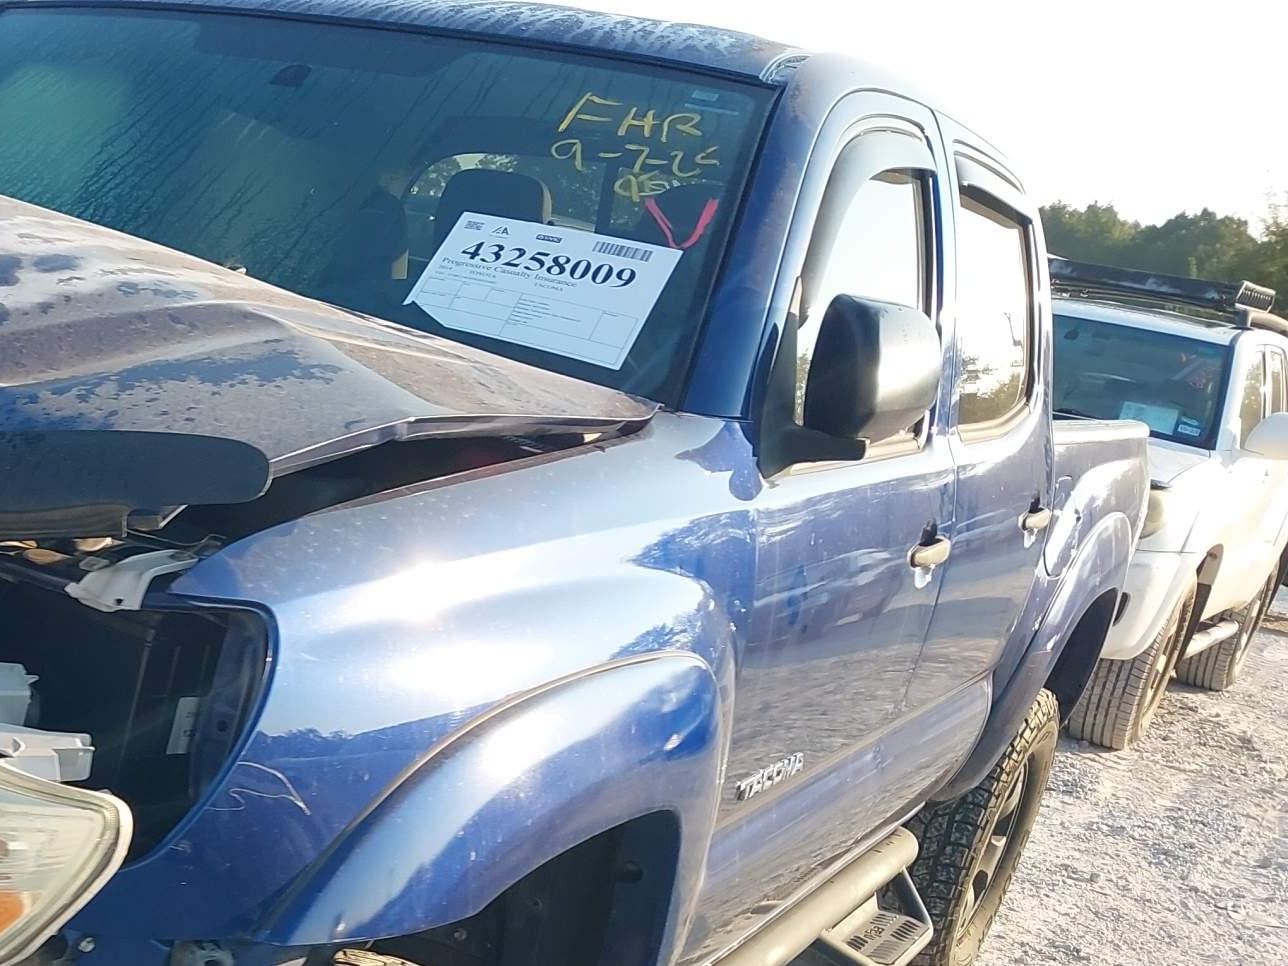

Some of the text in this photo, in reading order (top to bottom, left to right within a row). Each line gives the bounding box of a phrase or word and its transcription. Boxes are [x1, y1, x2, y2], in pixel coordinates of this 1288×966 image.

[441, 257, 492, 270] Progressive
[493, 266, 532, 279] Casualty
[534, 273, 577, 287] Insurance
[462, 241, 638, 286] 43258009
[736, 752, 804, 801] TACOMA
